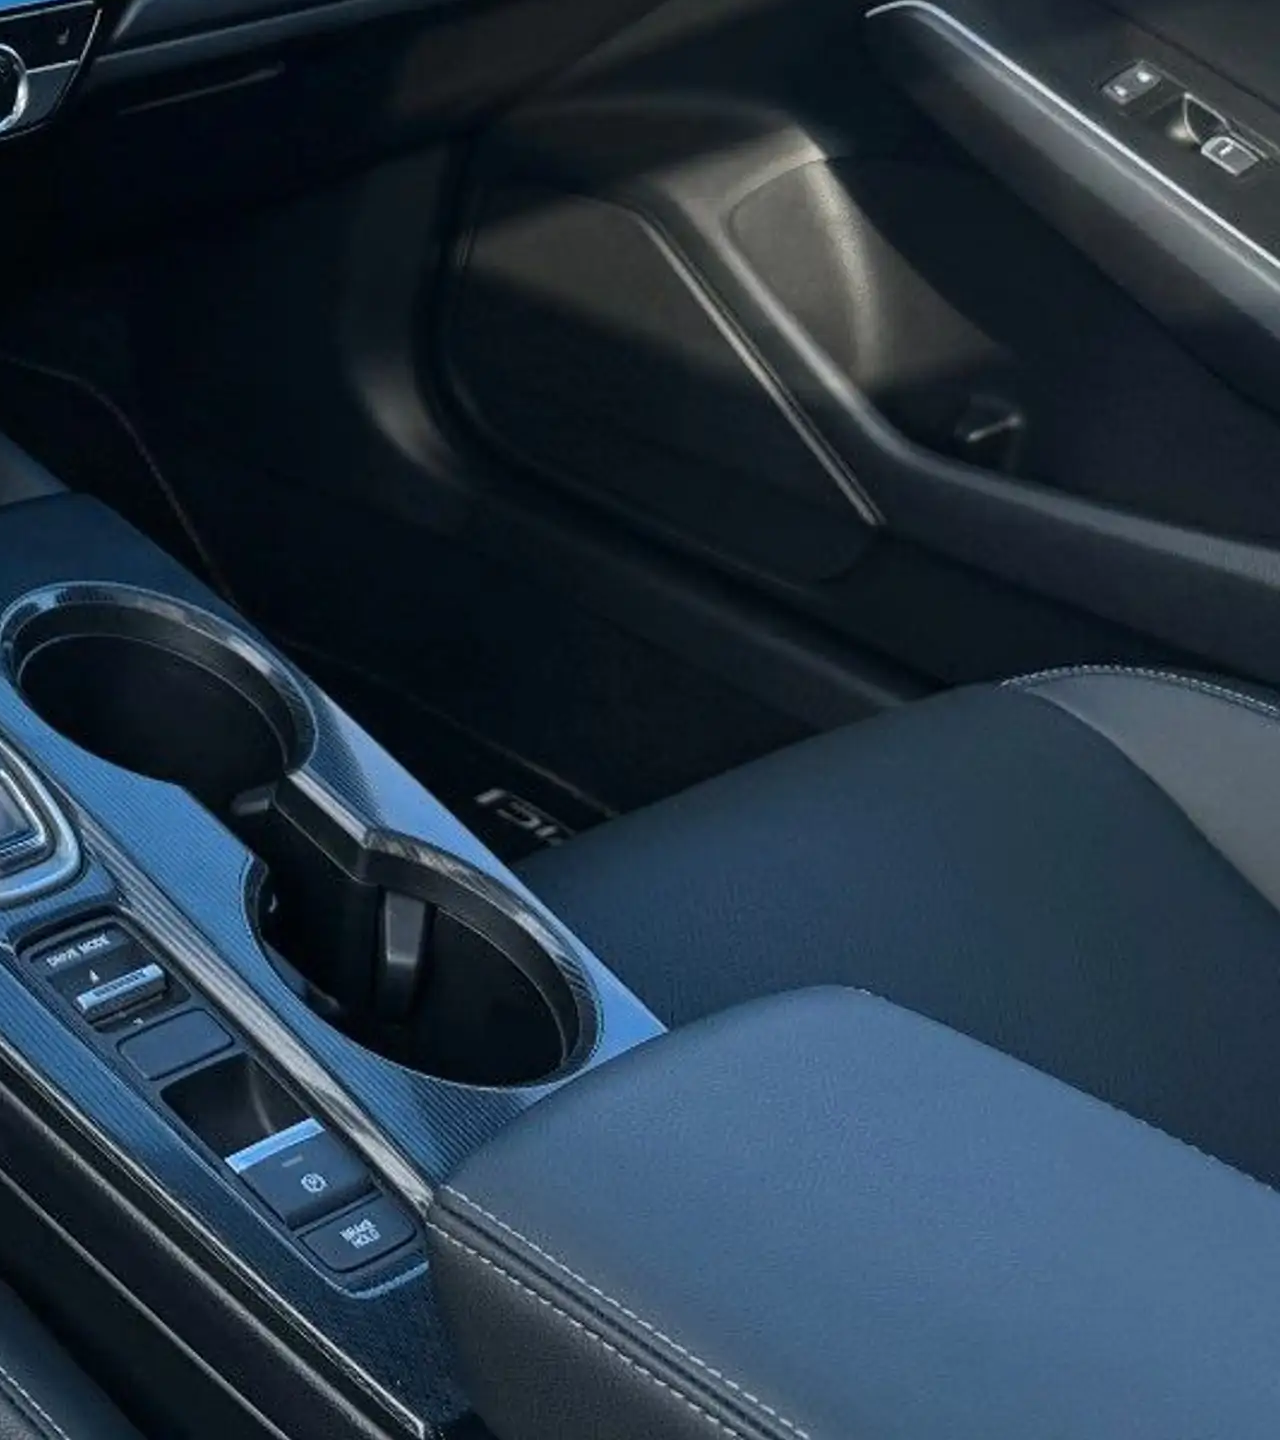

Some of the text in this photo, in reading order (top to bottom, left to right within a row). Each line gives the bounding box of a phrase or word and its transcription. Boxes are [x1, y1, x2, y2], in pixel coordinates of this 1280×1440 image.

[46, 933, 112, 968] DRIVE MODE
[339, 1218, 377, 1242] BRAKE
[351, 1228, 382, 1250] HOLD
